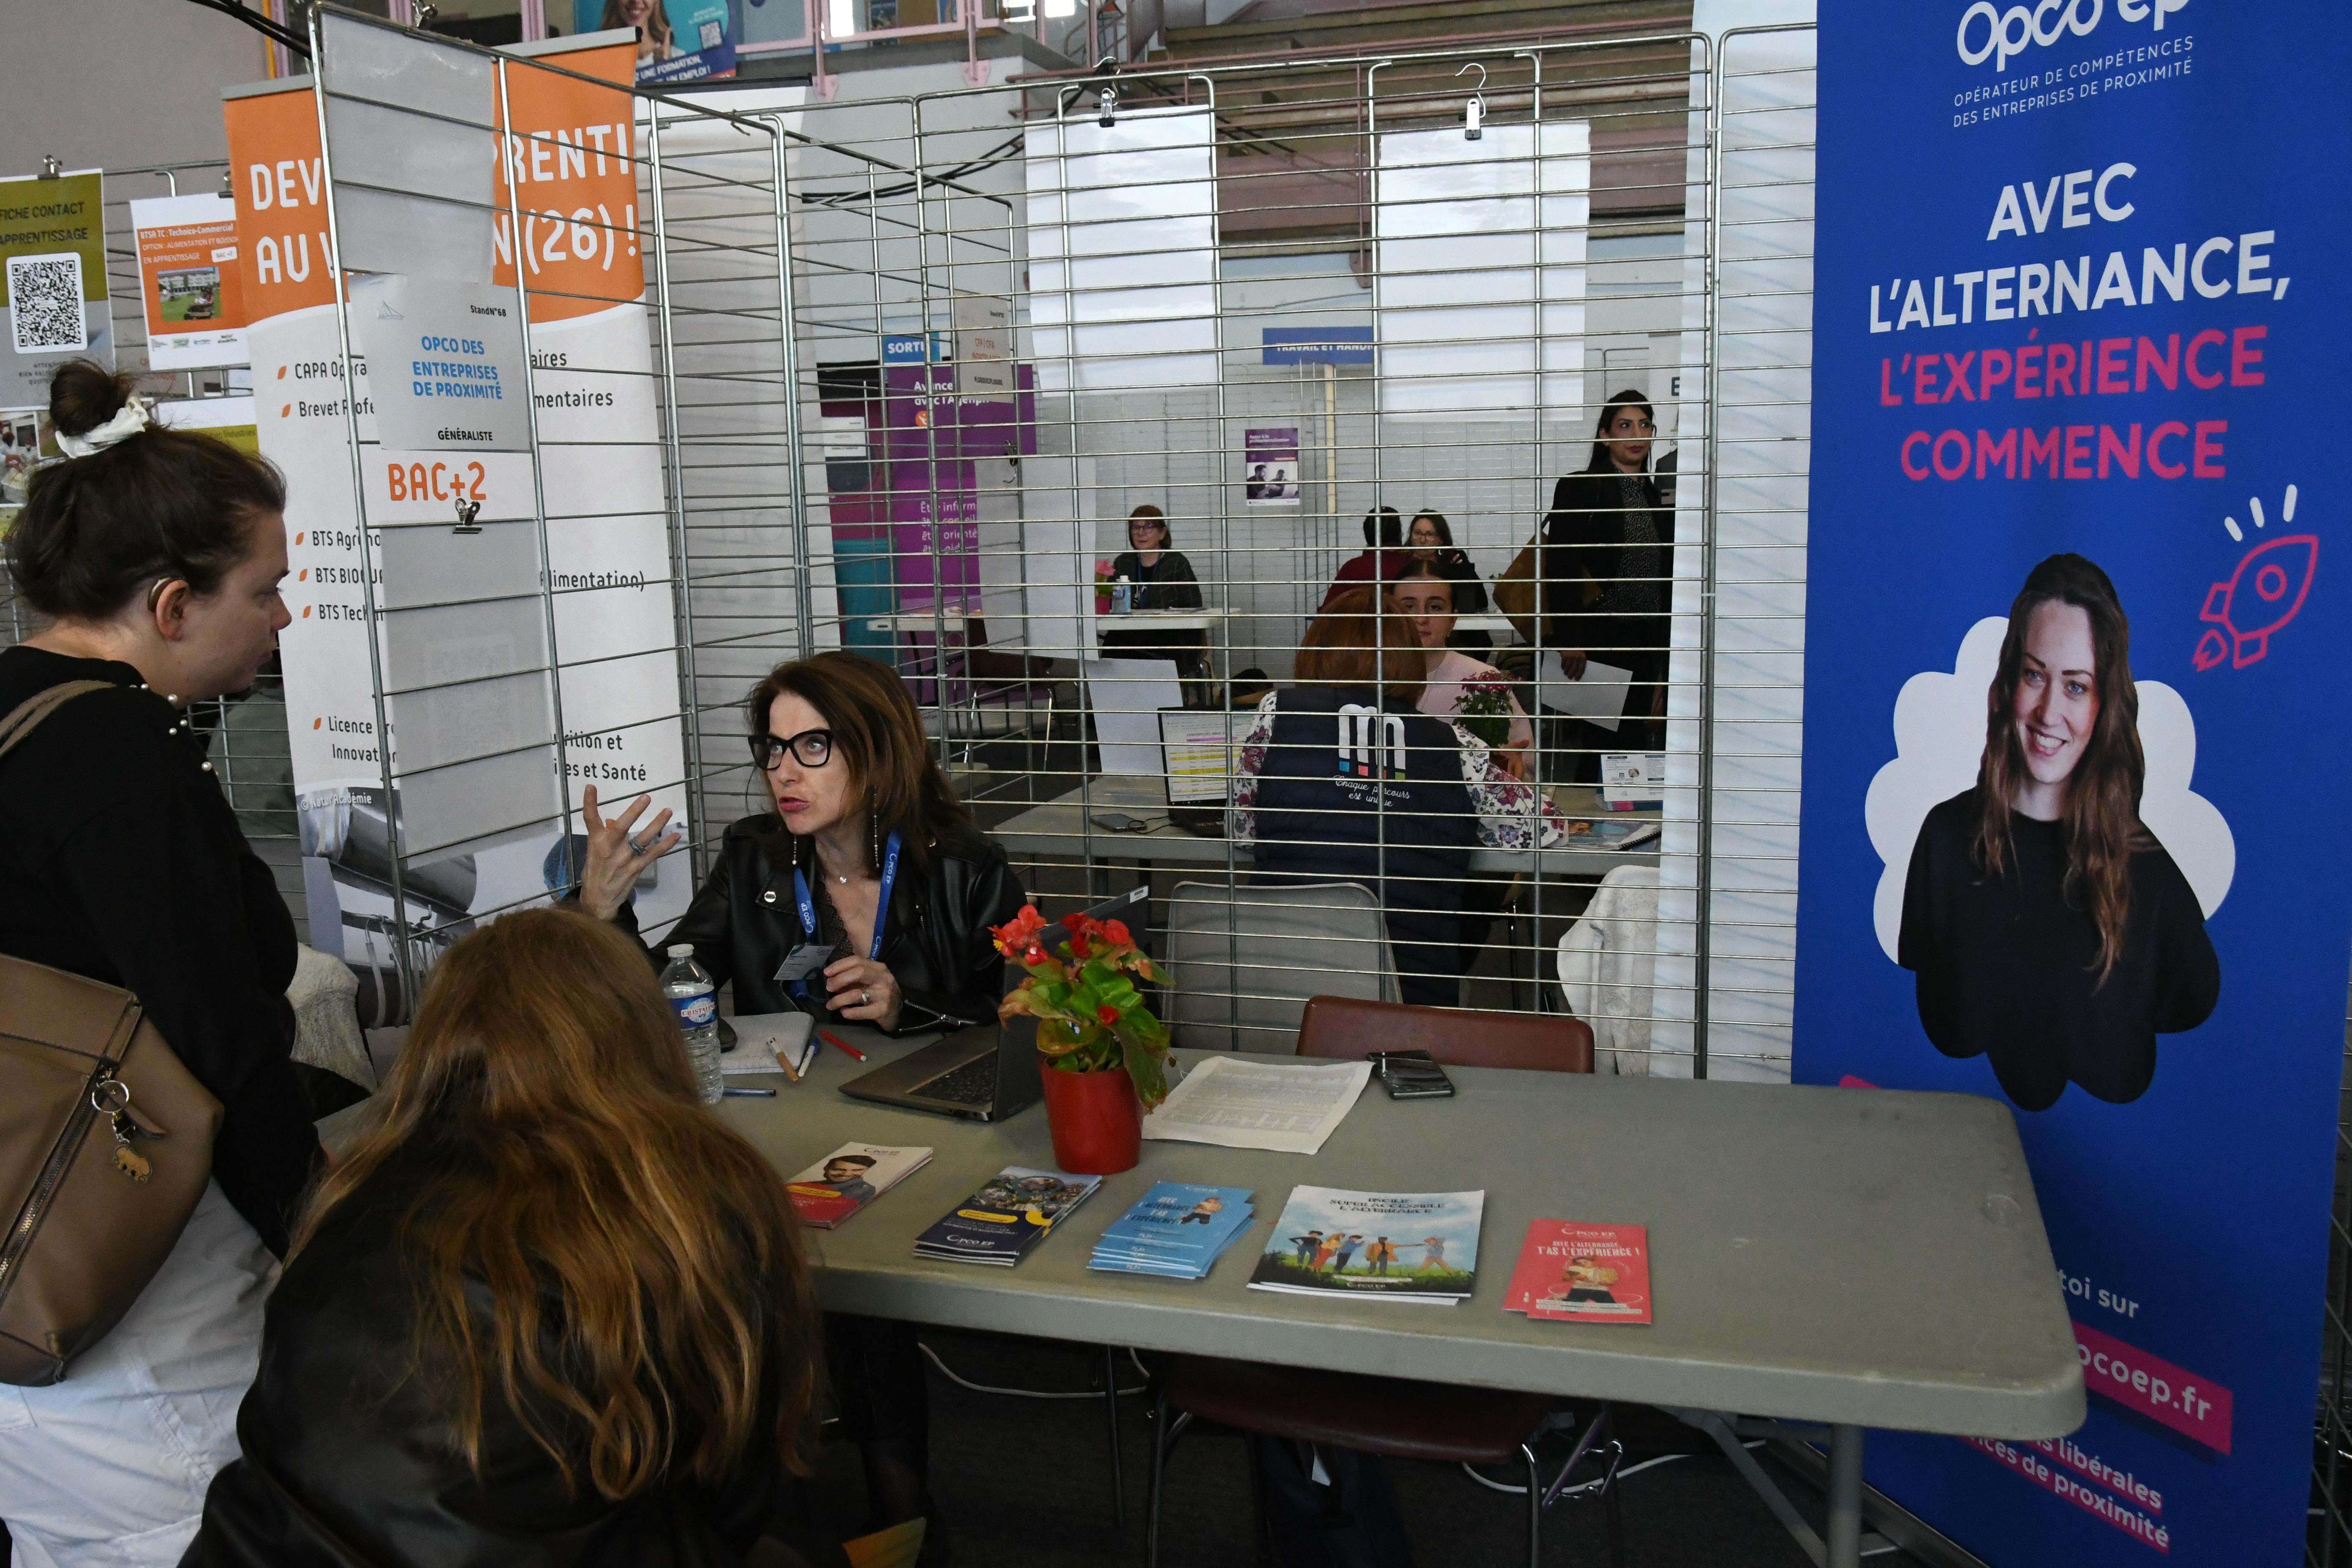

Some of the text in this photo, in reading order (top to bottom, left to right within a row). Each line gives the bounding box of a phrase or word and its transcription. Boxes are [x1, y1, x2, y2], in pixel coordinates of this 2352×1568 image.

[1955, 36, 2193, 106] OPÉRATEUR DE COMPÉTENCES
[1954, 56, 2192, 128] DES ENTREPRISES DE PROXIMITÉ
[33, 202, 84, 218] CONTACT
[1987, 162, 2137, 241] AVEC
[0, 228, 87, 245] APPRENTISSAGE
[167, 239, 207, 248] ALIMENTATION
[153, 253, 200, 262] APPRENTISSAGE
[256, 234, 309, 284] AU
[1869, 229, 2290, 334] L'ALTERNANCE,
[422, 336, 485, 355] OPCO DES
[888, 341, 924, 354] SORTI
[295, 362, 327, 379] CAPA
[413, 361, 498, 380] ENTREPRISES
[1880, 325, 2268, 407] L'EXPÉRIENCE
[413, 381, 503, 400] DE PROXIMITÉ
[299, 401, 339, 416] Brevet
[534, 388, 613, 408] mentaires
[438, 427, 493, 441] GÉNÉRALISTE
[1900, 419, 2229, 481] COMMENCE
[388, 461, 486, 501] BAC+2
[313, 531, 333, 546] BTS
[316, 568, 336, 583] BTS
[319, 604, 339, 620] BTS
[329, 716, 372, 734] Licence
[607, 735, 623, 750] et
[584, 763, 597, 778] et
[602, 763, 646, 781] Santé
[1372, 786, 1410, 799] prcours
[1537, 1246, 1559, 1255] T'AS
[2099, 1289, 2139, 1318] sur
[2058, 1437, 2161, 1509] libérales
[2023, 1455, 2049, 1481] de
[2055, 1473, 2169, 1547] proximité
